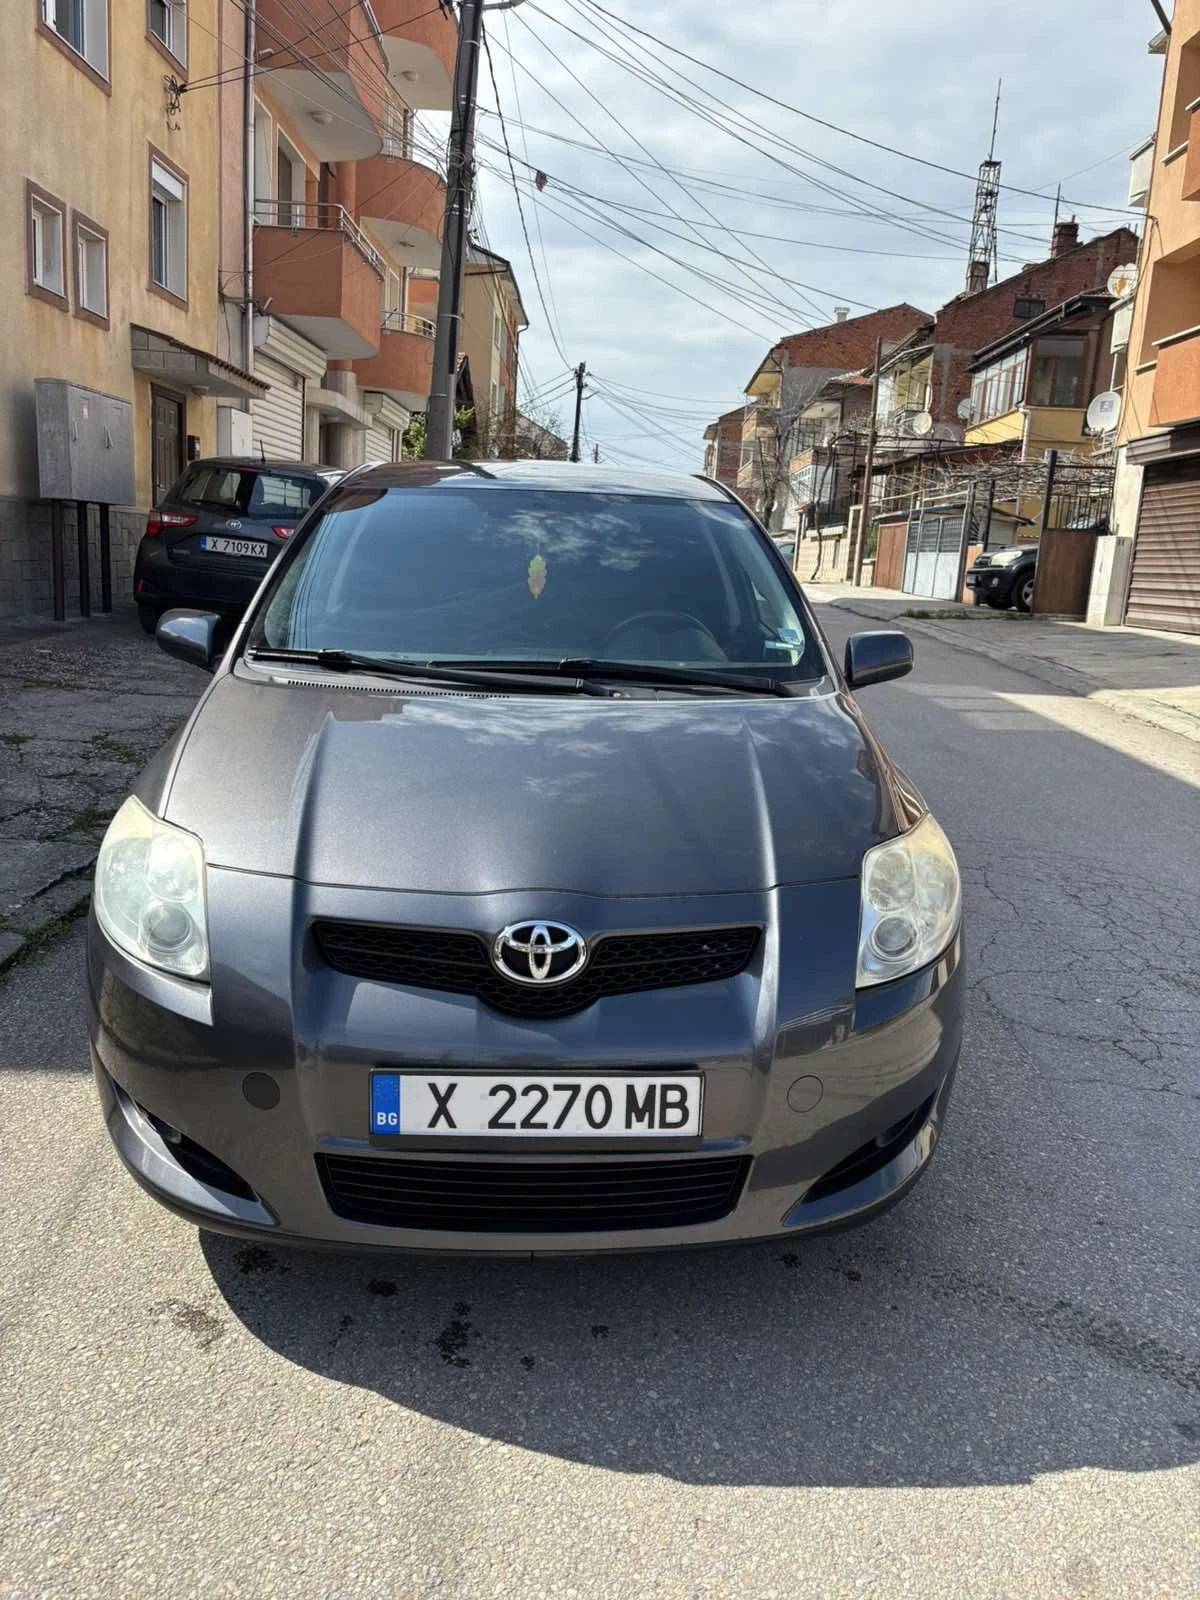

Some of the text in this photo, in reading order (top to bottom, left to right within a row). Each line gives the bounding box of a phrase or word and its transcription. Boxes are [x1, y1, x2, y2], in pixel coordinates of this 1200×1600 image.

[211, 538, 217, 550] X
[427, 1082, 690, 1130] X 2270 MB
[376, 1111, 399, 1126] BG
